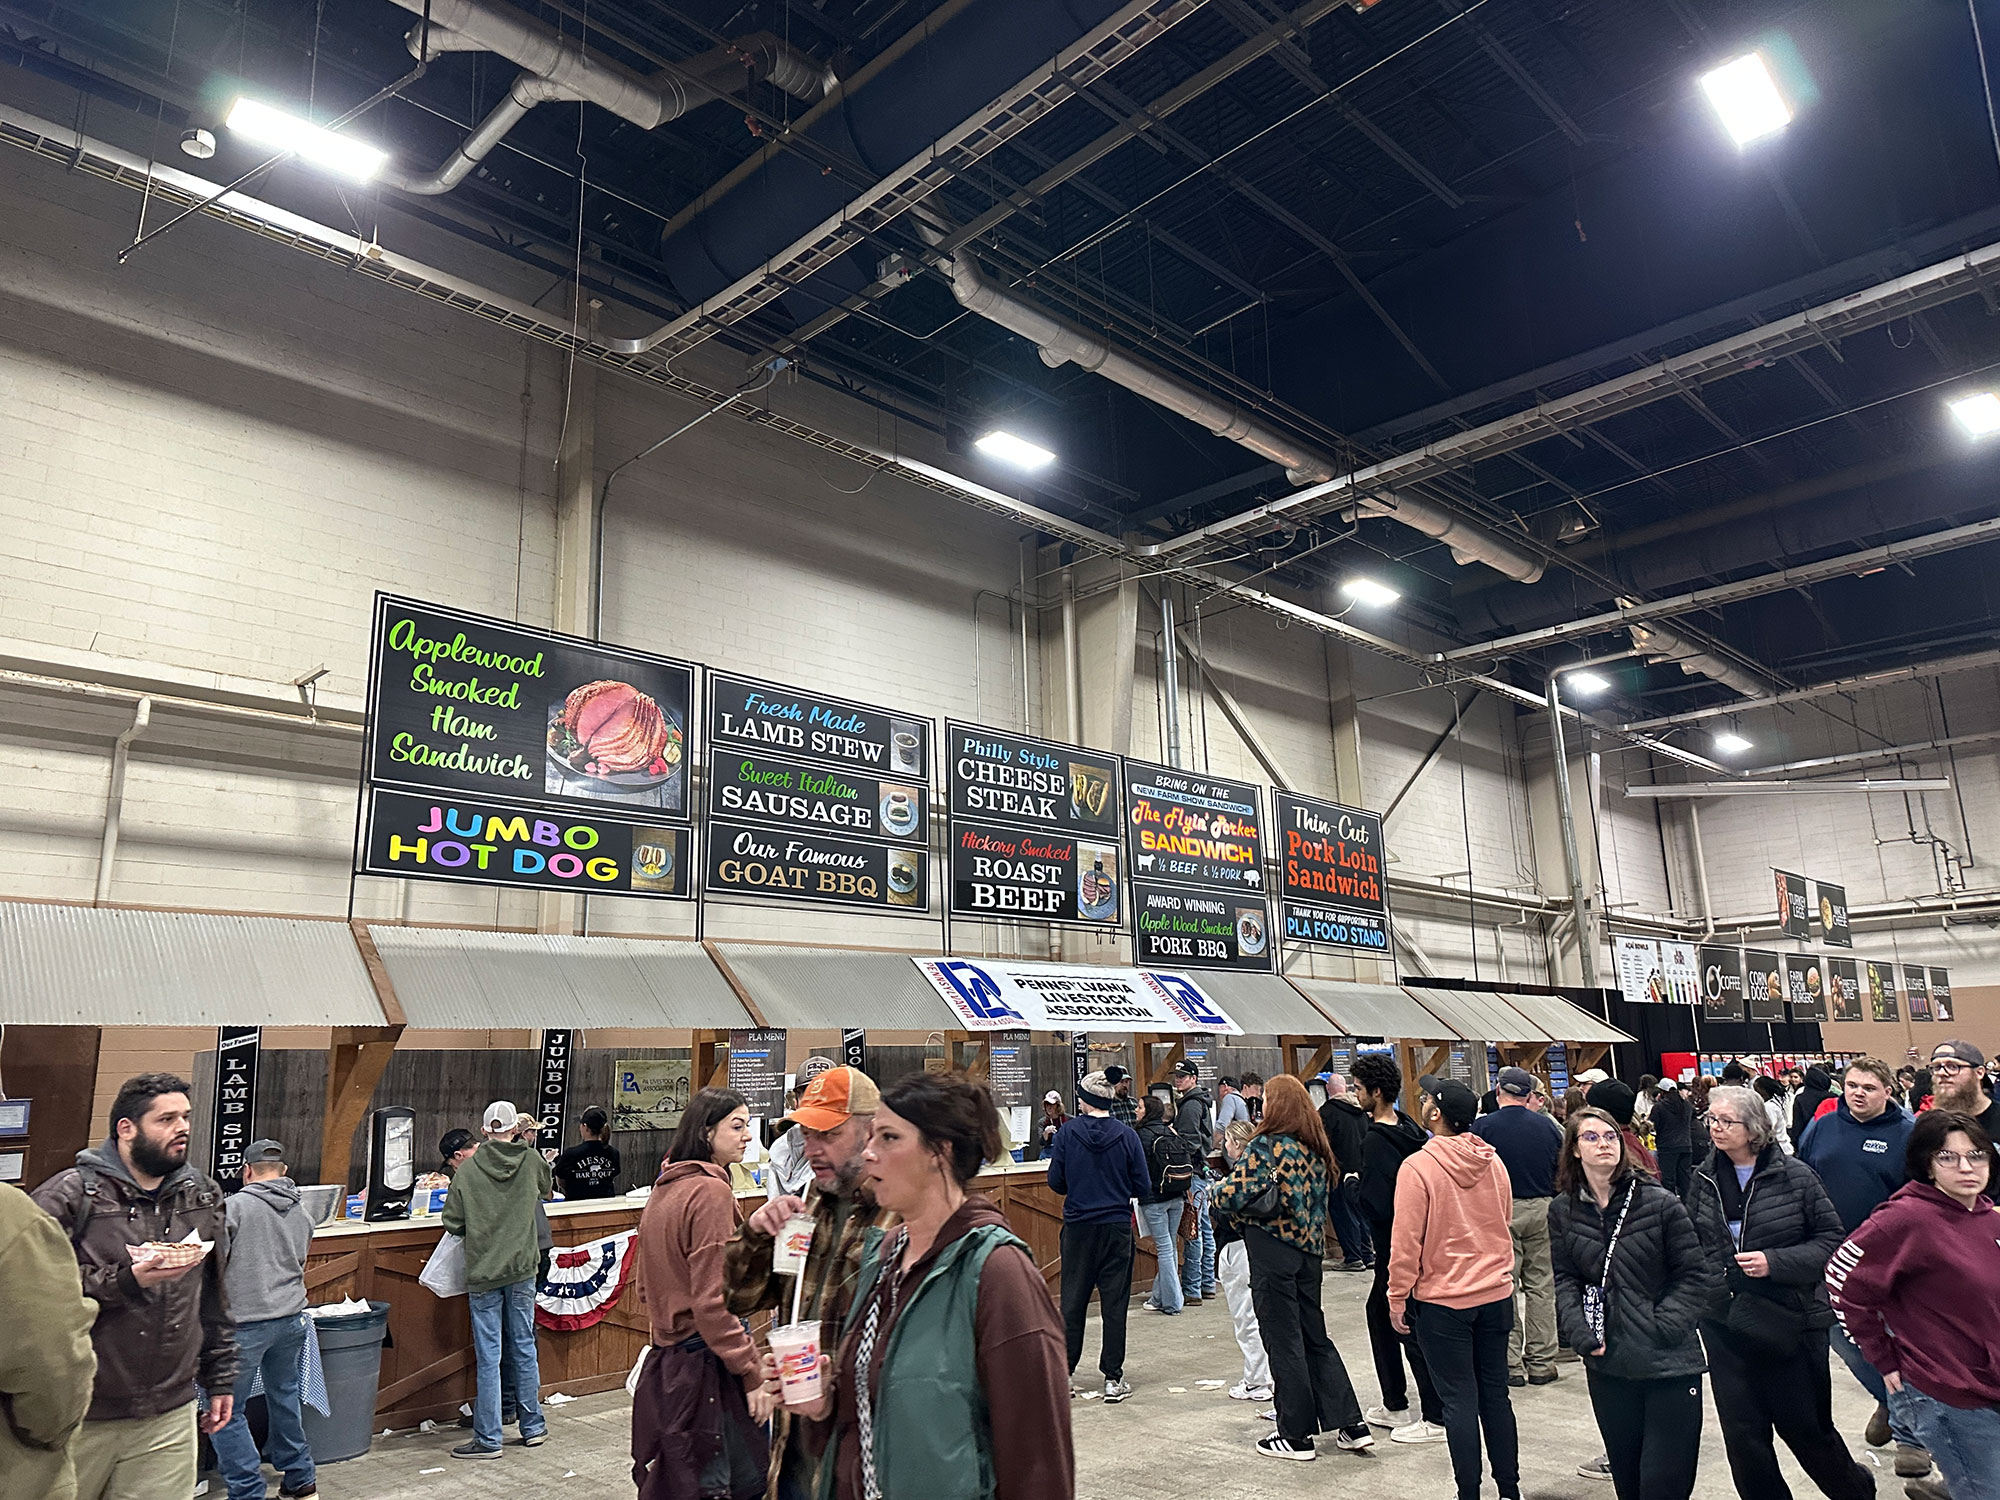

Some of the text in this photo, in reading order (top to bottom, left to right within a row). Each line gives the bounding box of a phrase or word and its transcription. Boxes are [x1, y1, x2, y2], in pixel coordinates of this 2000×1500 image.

[388, 618, 547, 679] Applewood
[410, 662, 522, 711] Smoked
[429, 704, 498, 742] Ham
[743, 692, 868, 735] Fresh Made
[720, 712, 885, 763] LAMB STEW
[962, 737, 1060, 770] Philly Style
[389, 731, 534, 781] Sandwich
[738, 760, 859, 801] Sweet Italian
[957, 757, 1065, 797] CHEESE
[1155, 775, 1231, 799] BRING ON THE
[721, 785, 872, 829] SAUSAGE
[966, 785, 1058, 820] STEAK
[1136, 786, 1156, 798] NEW
[1157, 789, 1181, 802] FARM
[1181, 793, 1206, 806] SHOW
[416, 806, 600, 850] JUMBO
[1131, 799, 1161, 825] The
[1210, 814, 1258, 840] Porker
[1291, 805, 1370, 845] Thin-Cut
[388, 834, 620, 882] HOT DOG
[733, 831, 869, 870] Our Famous
[960, 830, 1072, 862] Hickory Smoked
[1140, 830, 1255, 865] SANDWICH
[1286, 829, 1379, 875] Pork Loin
[718, 859, 879, 898] GOAT BBQ
[972, 856, 1062, 886] ROAST
[1169, 860, 1199, 876] BEEF
[1203, 865, 1209, 877] &
[1220, 868, 1242, 881] PORK
[1287, 859, 1381, 902] Sandwich
[970, 883, 1066, 913] BEEF
[1147, 894, 1226, 915] AWARD WINNING
[1292, 906, 1312, 918] THANK
[1312, 908, 1324, 920] YOU
[1324, 911, 1337, 923] FOR
[1140, 910, 1235, 937] Apple Wood Smoked
[1286, 917, 1386, 948] PLA FOOD STAND
[1149, 935, 1228, 960] PORK BBQ
[923, 961, 976, 1020] PENNSYLVANIA
[1013, 978, 1136, 994] PENNSYLVANIA
[1720, 975, 1742, 991] COFFEE
[1749, 970, 1768, 986] CORN
[1750, 985, 1770, 1001] DOGS
[1040, 992, 1134, 1005] LIVESTOCK
[1045, 1004, 1154, 1018] ASSOCIATION
[1138, 971, 1191, 1023] PENNSYLVANIA
[221, 1034, 258, 1049] Our Famous
[748, 1032, 786, 1042] PLA MENU
[544, 1034, 567, 1095] JUMBO
[221, 1058, 248, 1115] LAMB
[542, 1103, 562, 1139] HOT
[217, 1122, 245, 1180] STEW
[575, 1171, 590, 1179] BAR
